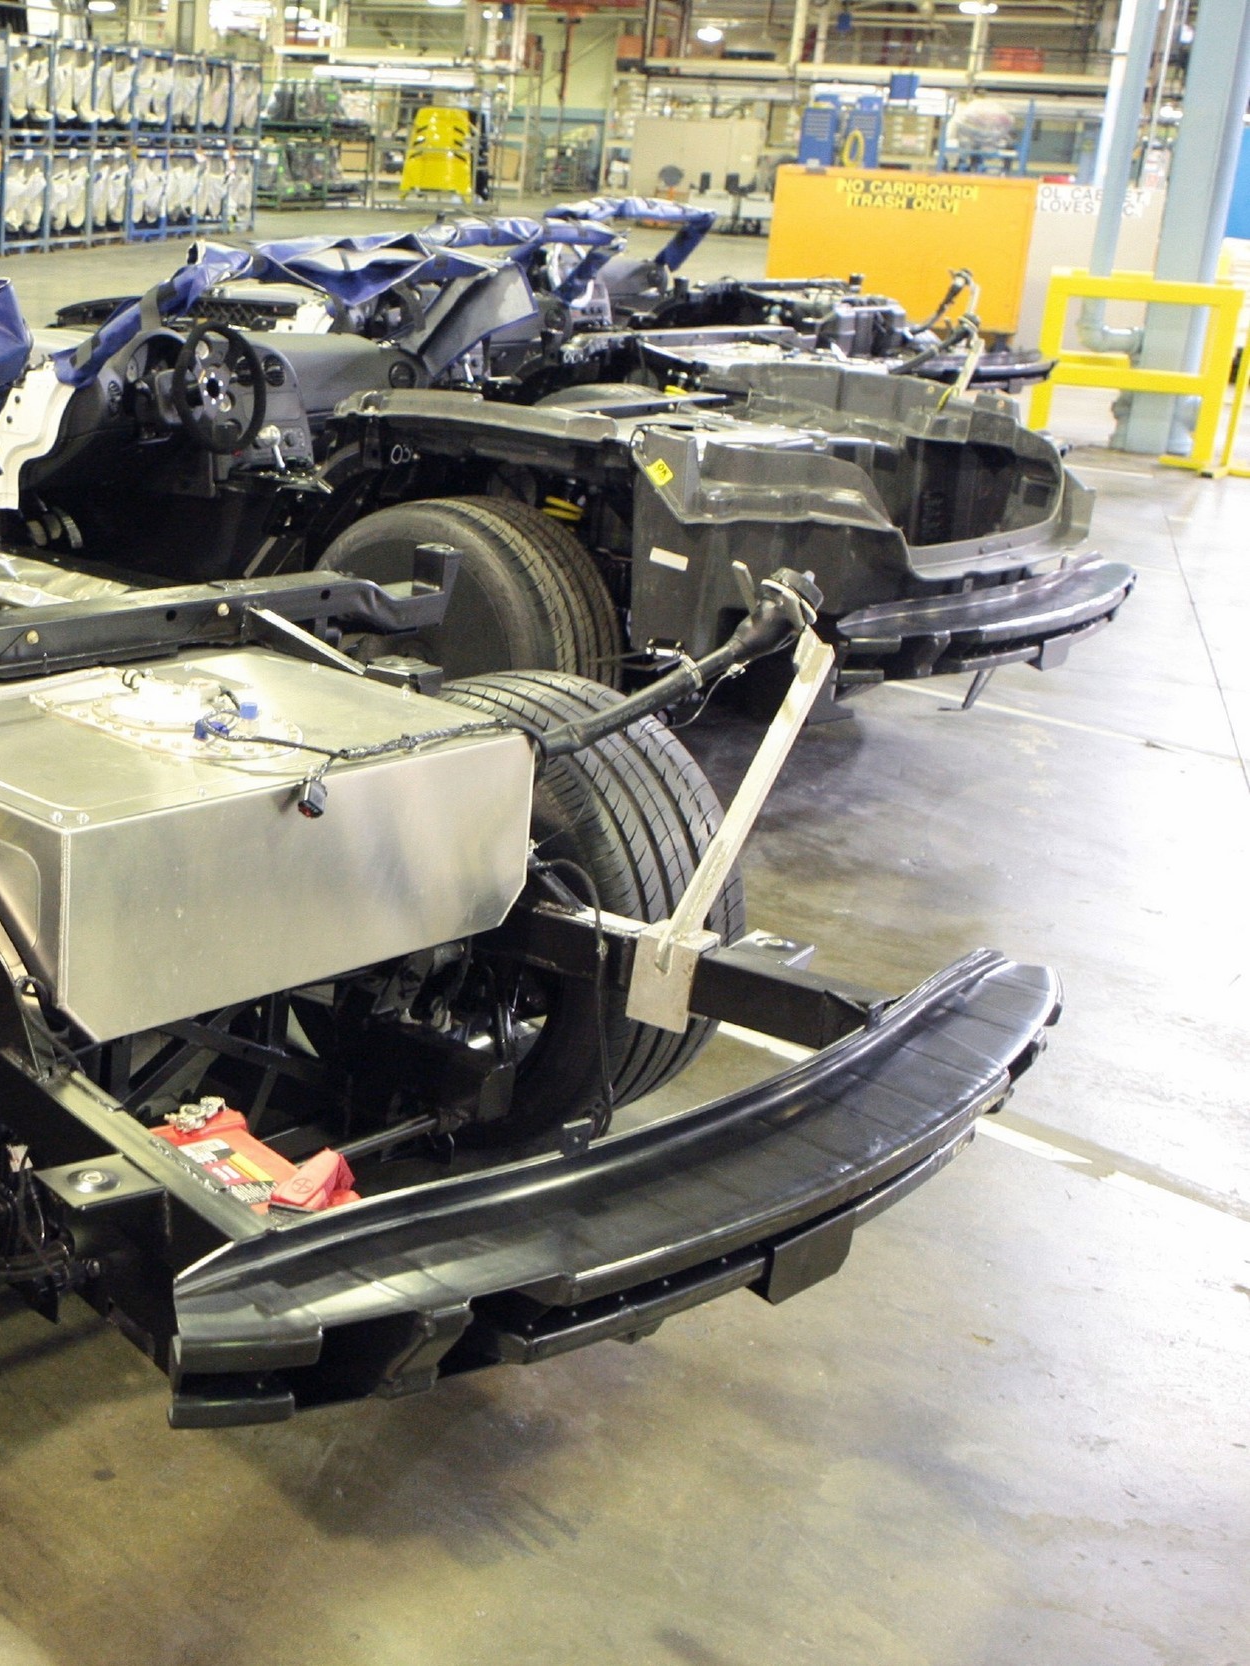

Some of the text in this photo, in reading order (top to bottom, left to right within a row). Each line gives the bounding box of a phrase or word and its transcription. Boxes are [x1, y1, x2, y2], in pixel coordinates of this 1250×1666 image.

[841, 178, 975, 200] NO CARDBOARD
[1040, 186, 1062, 200] OL
[852, 193, 955, 212] TRASH ONLY
[1036, 200, 1095, 214] LOVES
